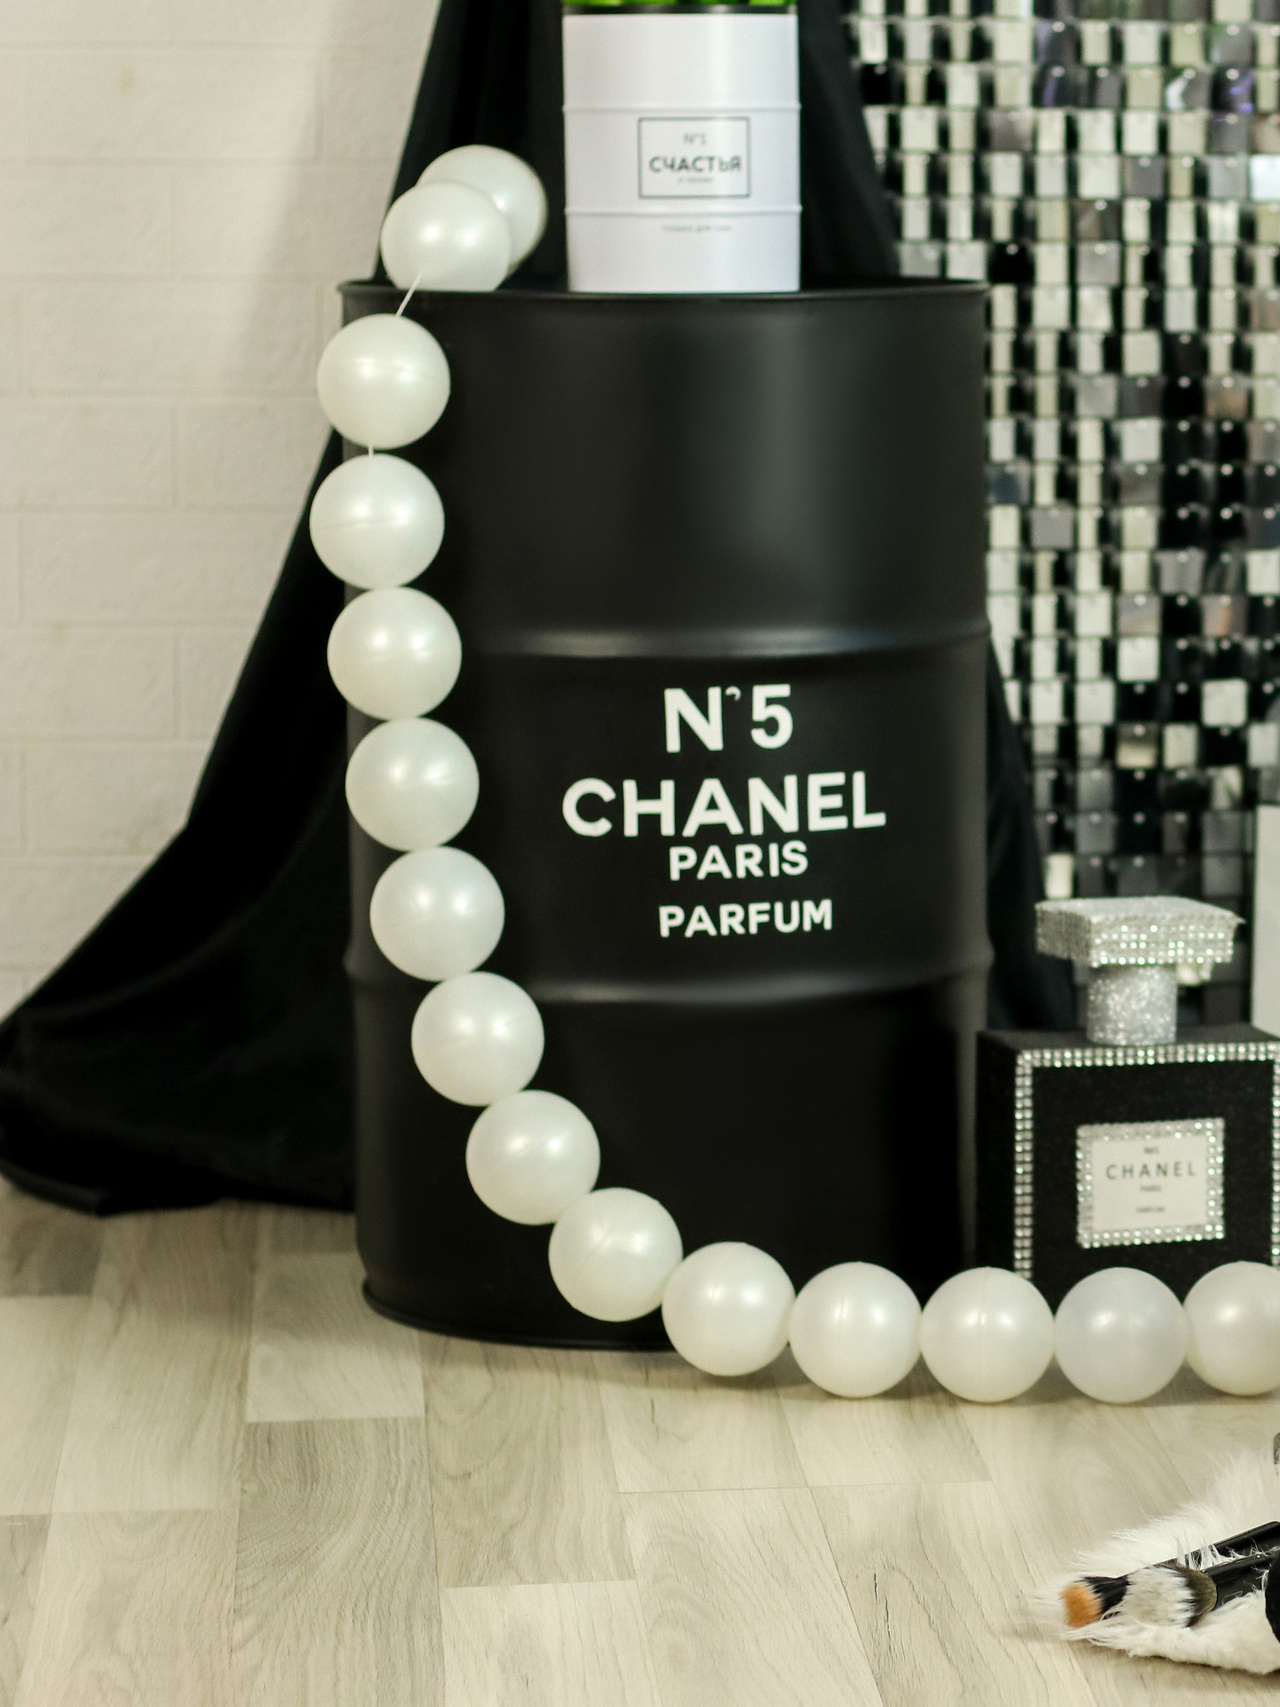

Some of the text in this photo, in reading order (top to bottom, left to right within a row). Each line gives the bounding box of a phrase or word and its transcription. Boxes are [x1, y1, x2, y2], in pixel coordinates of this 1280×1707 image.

[649, 155, 742, 173] СЧАСТЬЯ
[561, 770, 887, 838] CHANEL
[669, 840, 809, 882] PARIS
[658, 898, 833, 939] PARFUM
[1105, 1160, 1197, 1180] CHANEL
